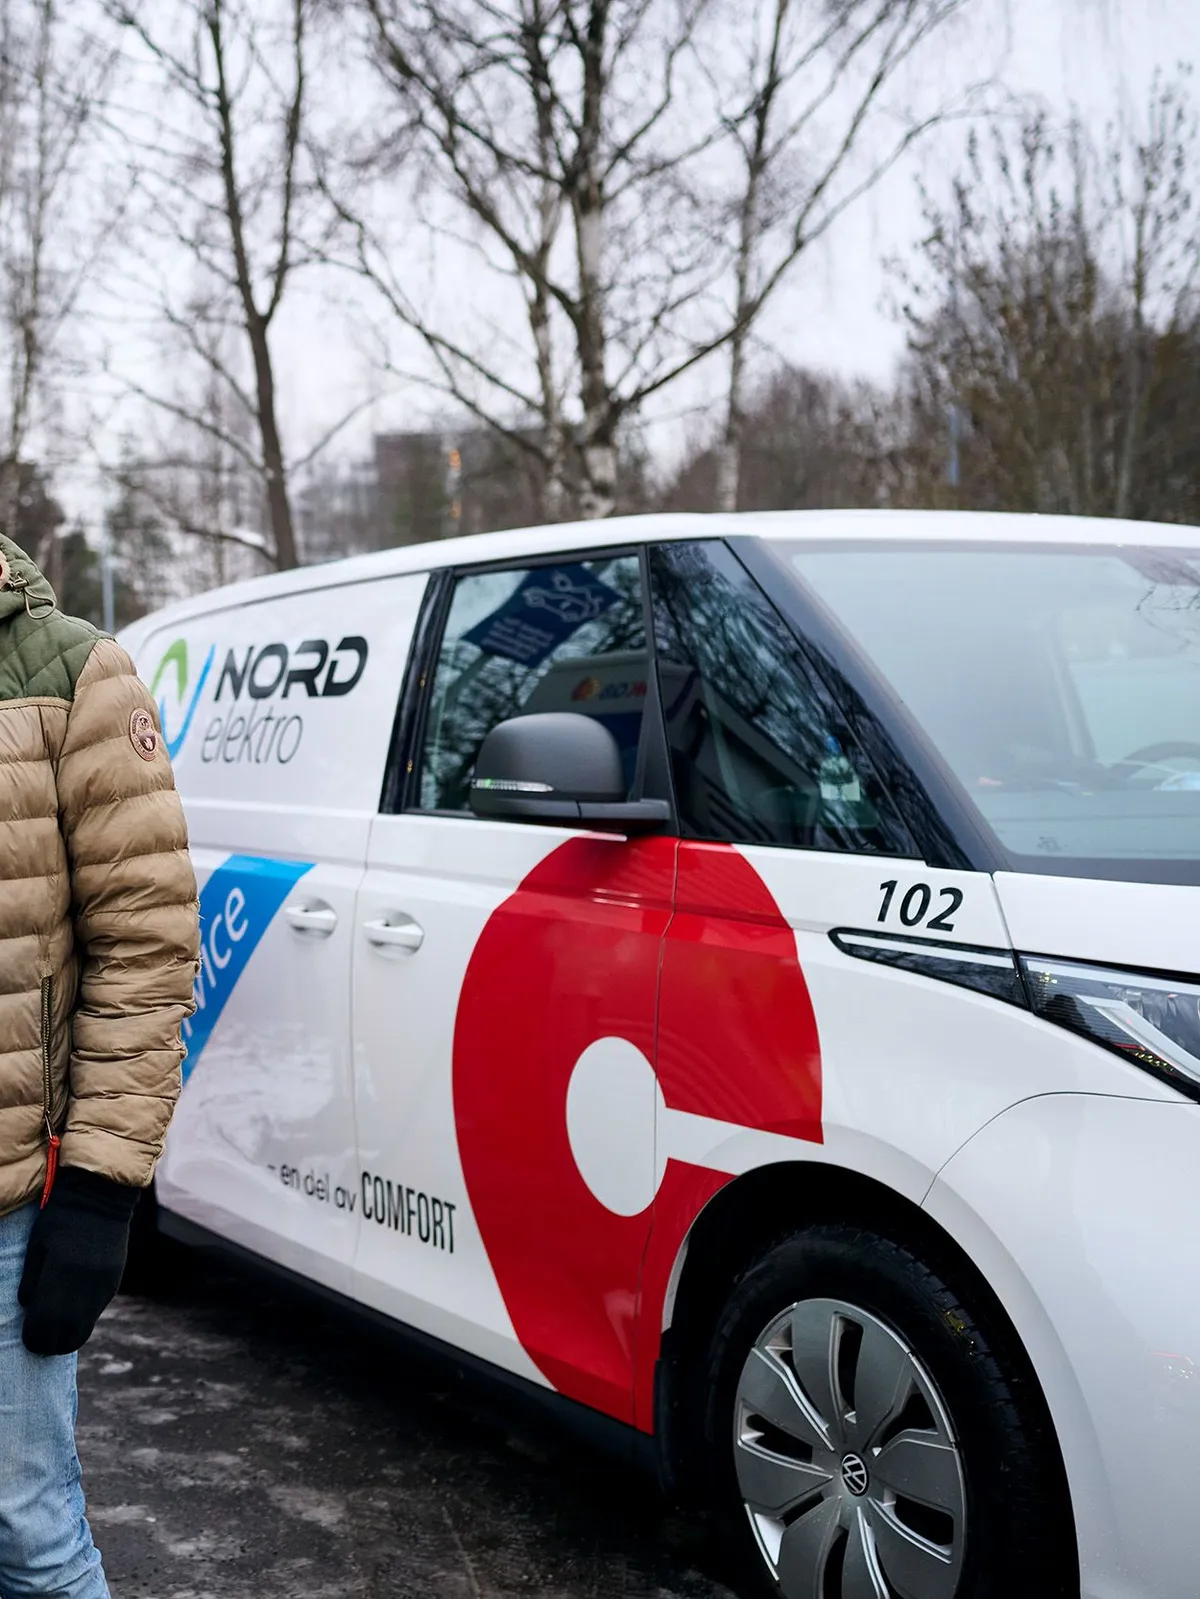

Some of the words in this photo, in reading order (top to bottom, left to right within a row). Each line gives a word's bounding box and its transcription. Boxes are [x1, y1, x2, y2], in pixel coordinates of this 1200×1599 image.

[214, 636, 369, 702] NORD
[201, 702, 304, 764] elektro
[877, 880, 964, 932] 102
[182, 887, 249, 1038] vice
[280, 1164, 300, 1189] en
[303, 1168, 330, 1202] del
[334, 1186, 358, 1212] av
[361, 1171, 456, 1254] COMFORT
